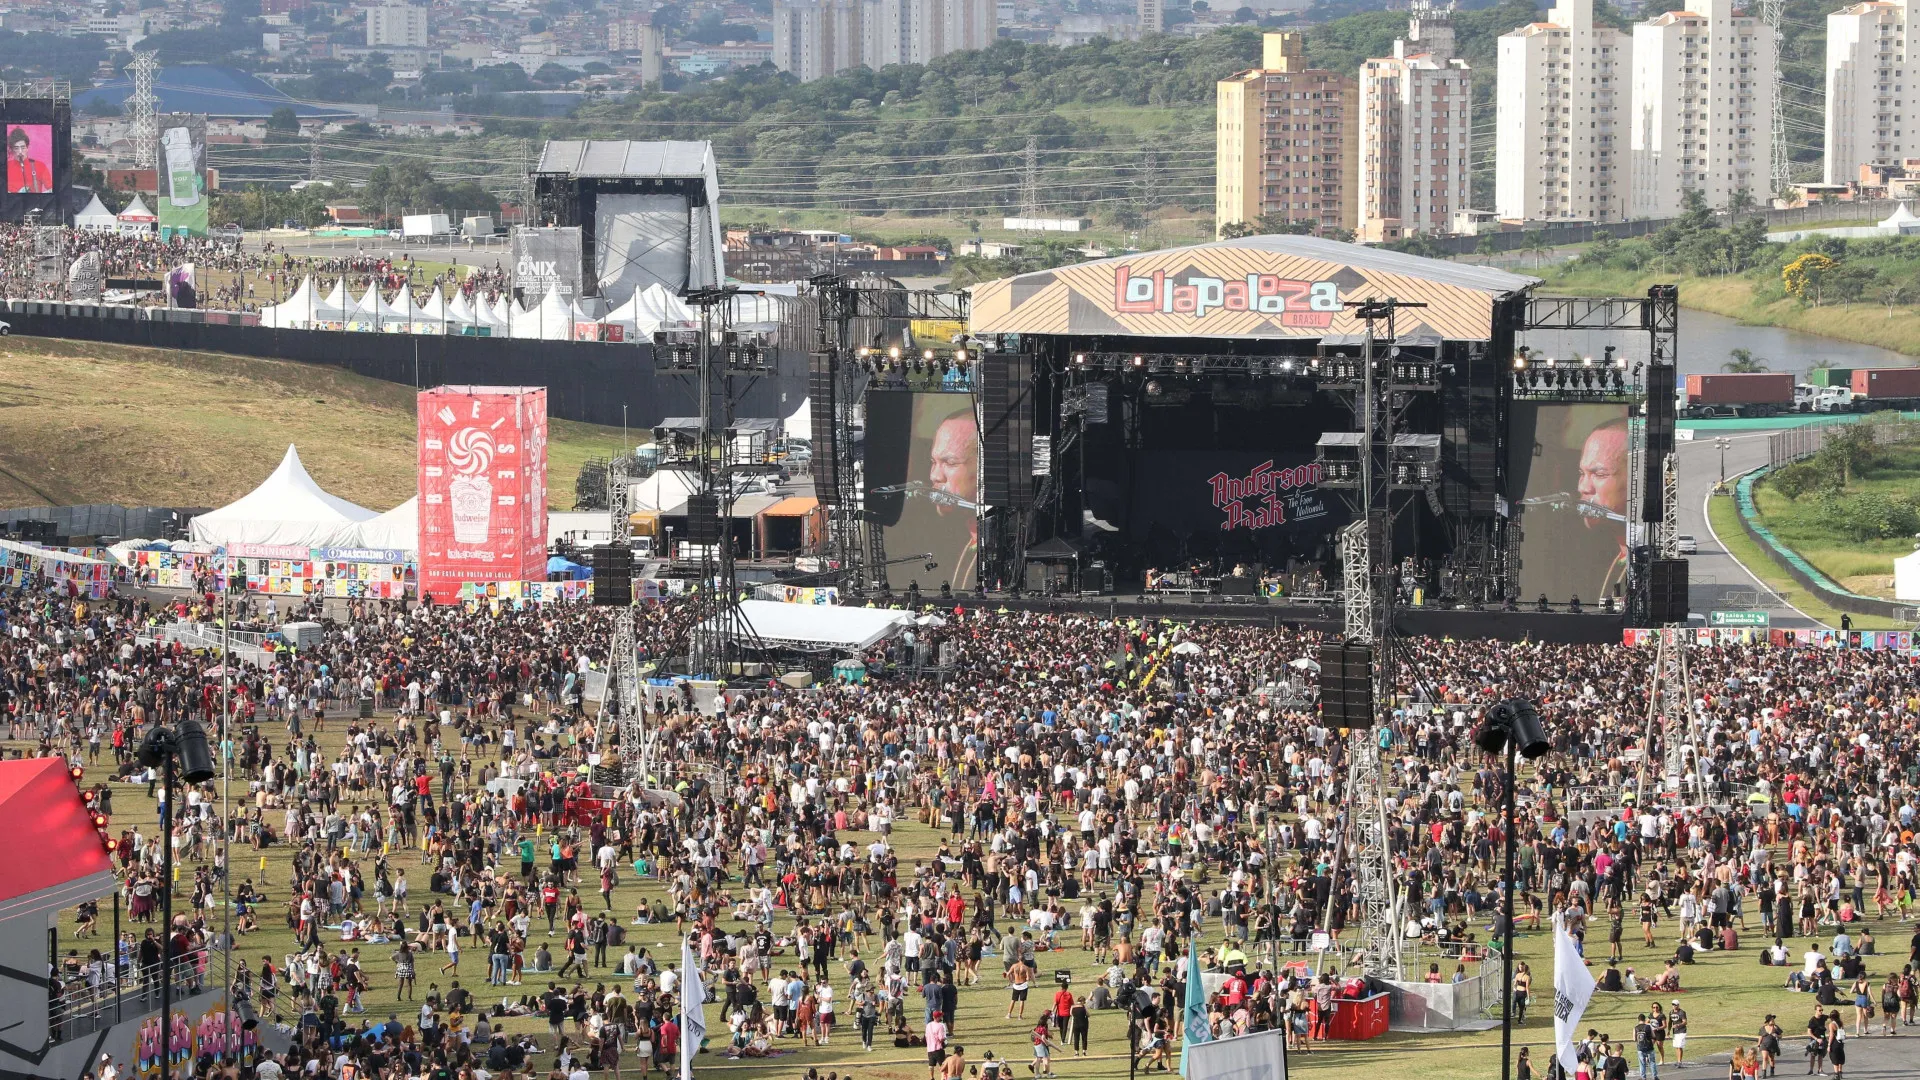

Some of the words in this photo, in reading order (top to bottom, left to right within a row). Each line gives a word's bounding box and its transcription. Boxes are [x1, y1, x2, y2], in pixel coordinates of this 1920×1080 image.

[517, 261, 556, 276] ONIX
[1115, 265, 1344, 317] Lollapalooza
[1292, 313, 1322, 326] BRASIL
[1207, 459, 1323, 508] Anderson
[245, 545, 291, 556] FEMININO
[339, 549, 384, 560] MASCULINO
